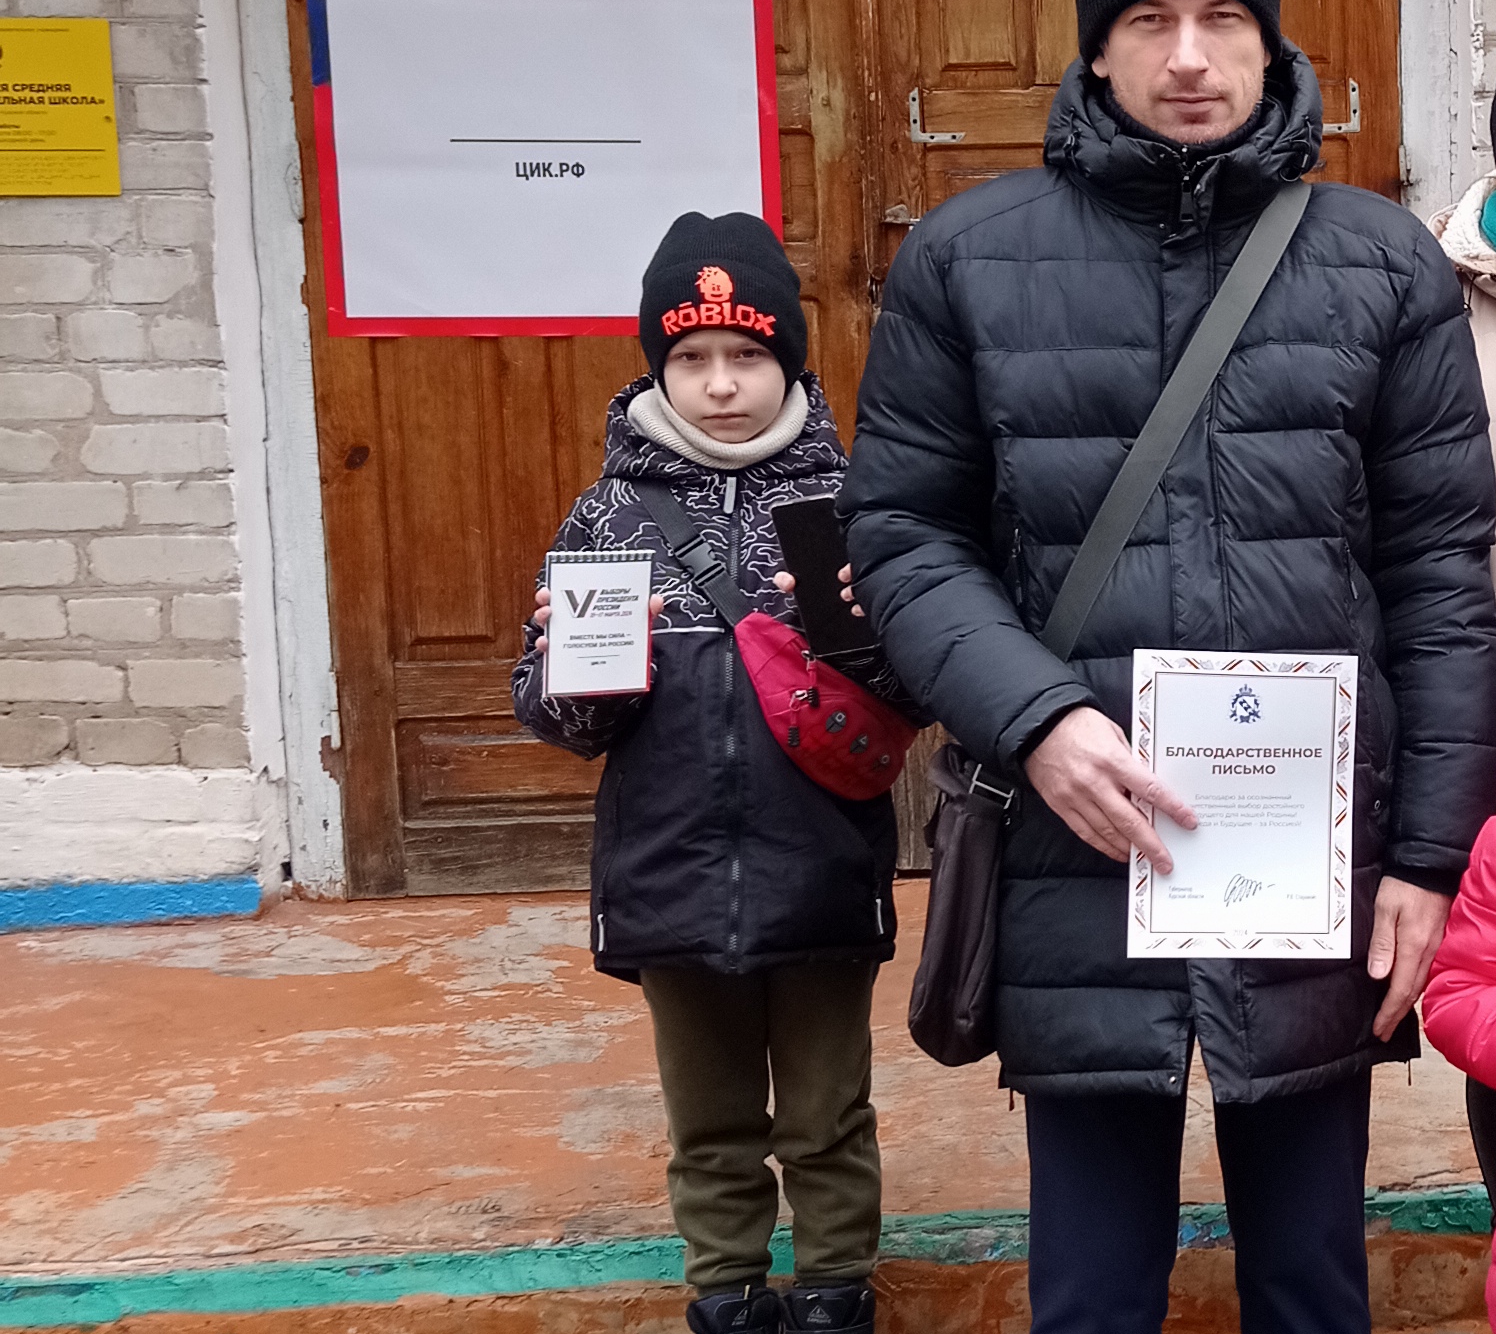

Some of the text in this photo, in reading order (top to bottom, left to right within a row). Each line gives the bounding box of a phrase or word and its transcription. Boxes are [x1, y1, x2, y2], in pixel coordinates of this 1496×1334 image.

[12, 82, 72, 93] СРЕДНЯЯ
[515, 162, 585, 181] ЦИК.РФ
[1165, 746, 1322, 759] БЛАГОДАРСТВЕННОЕ
[1212, 764, 1276, 775] ПИСЬМО
